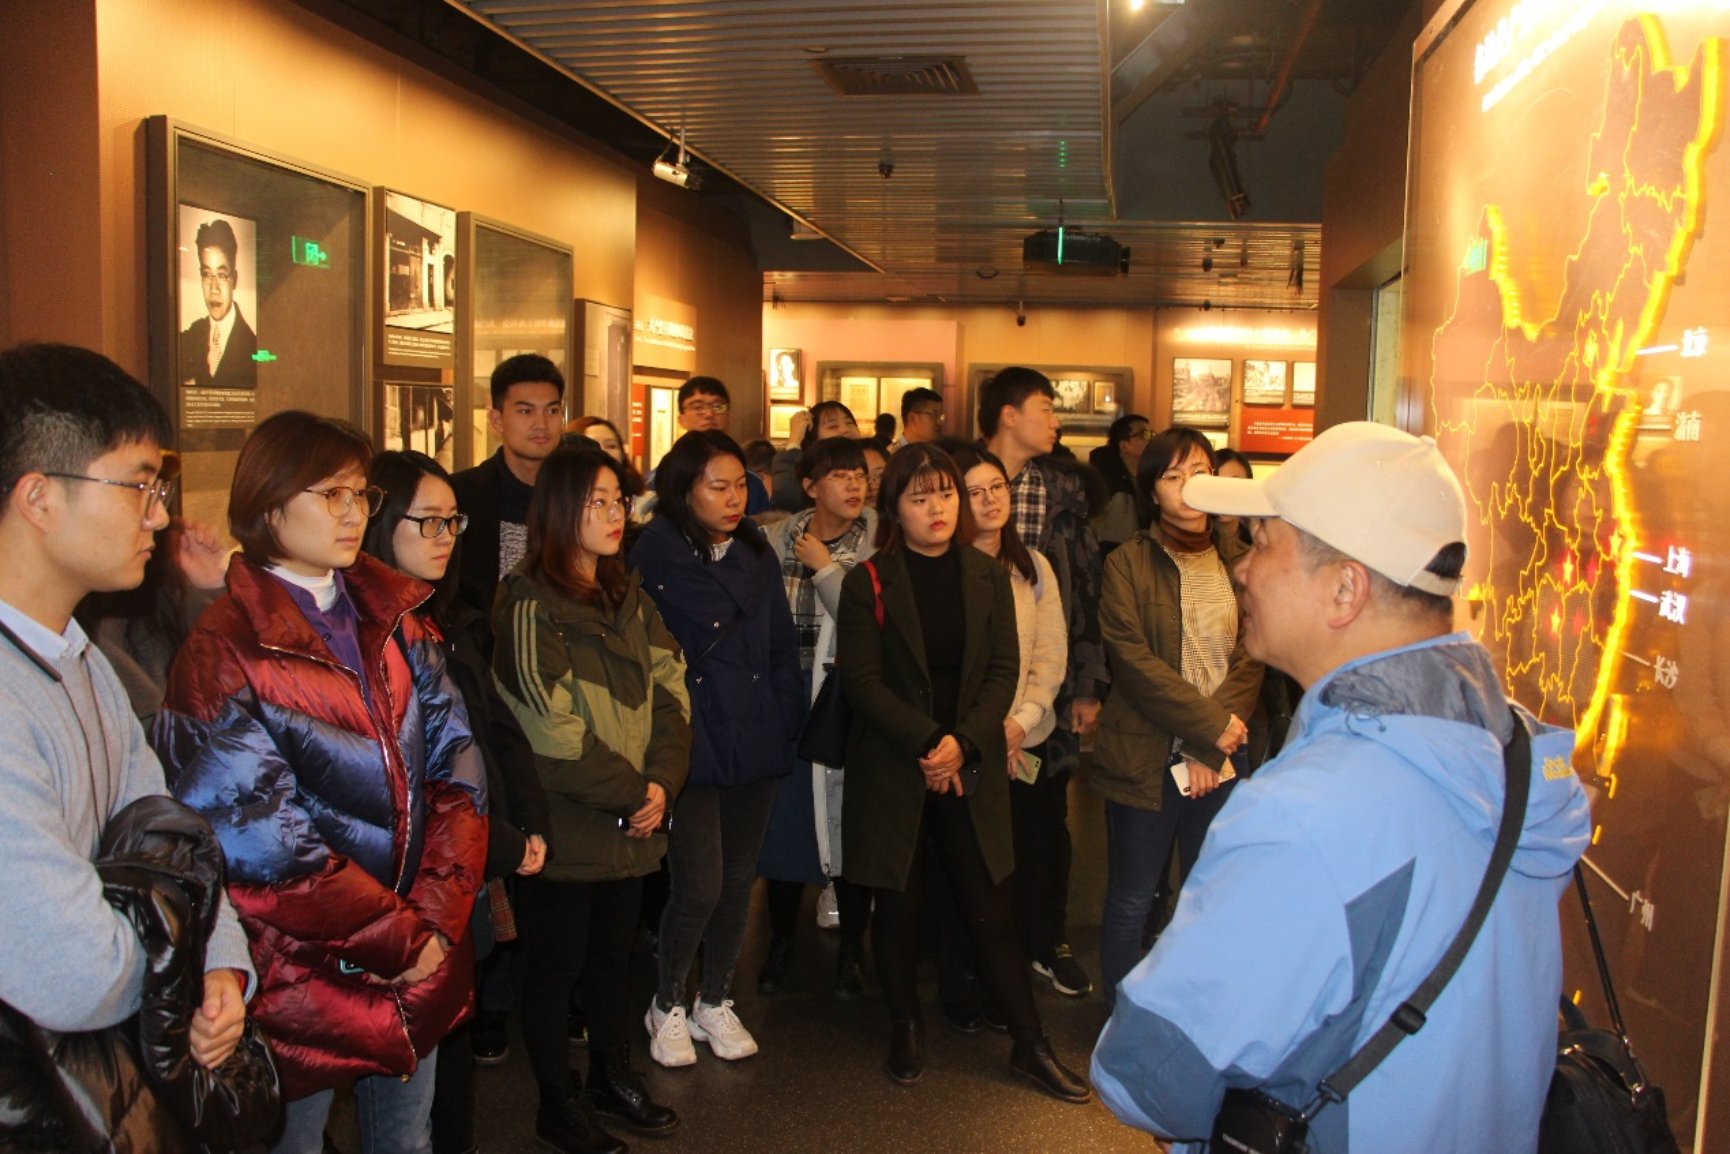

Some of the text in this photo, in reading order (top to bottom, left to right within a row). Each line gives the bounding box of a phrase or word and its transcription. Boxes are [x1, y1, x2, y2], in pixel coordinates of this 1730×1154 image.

[1663, 545, 1692, 578] 上海
[1654, 655, 1679, 689] 长沙
[1629, 890, 1655, 932] 广州
